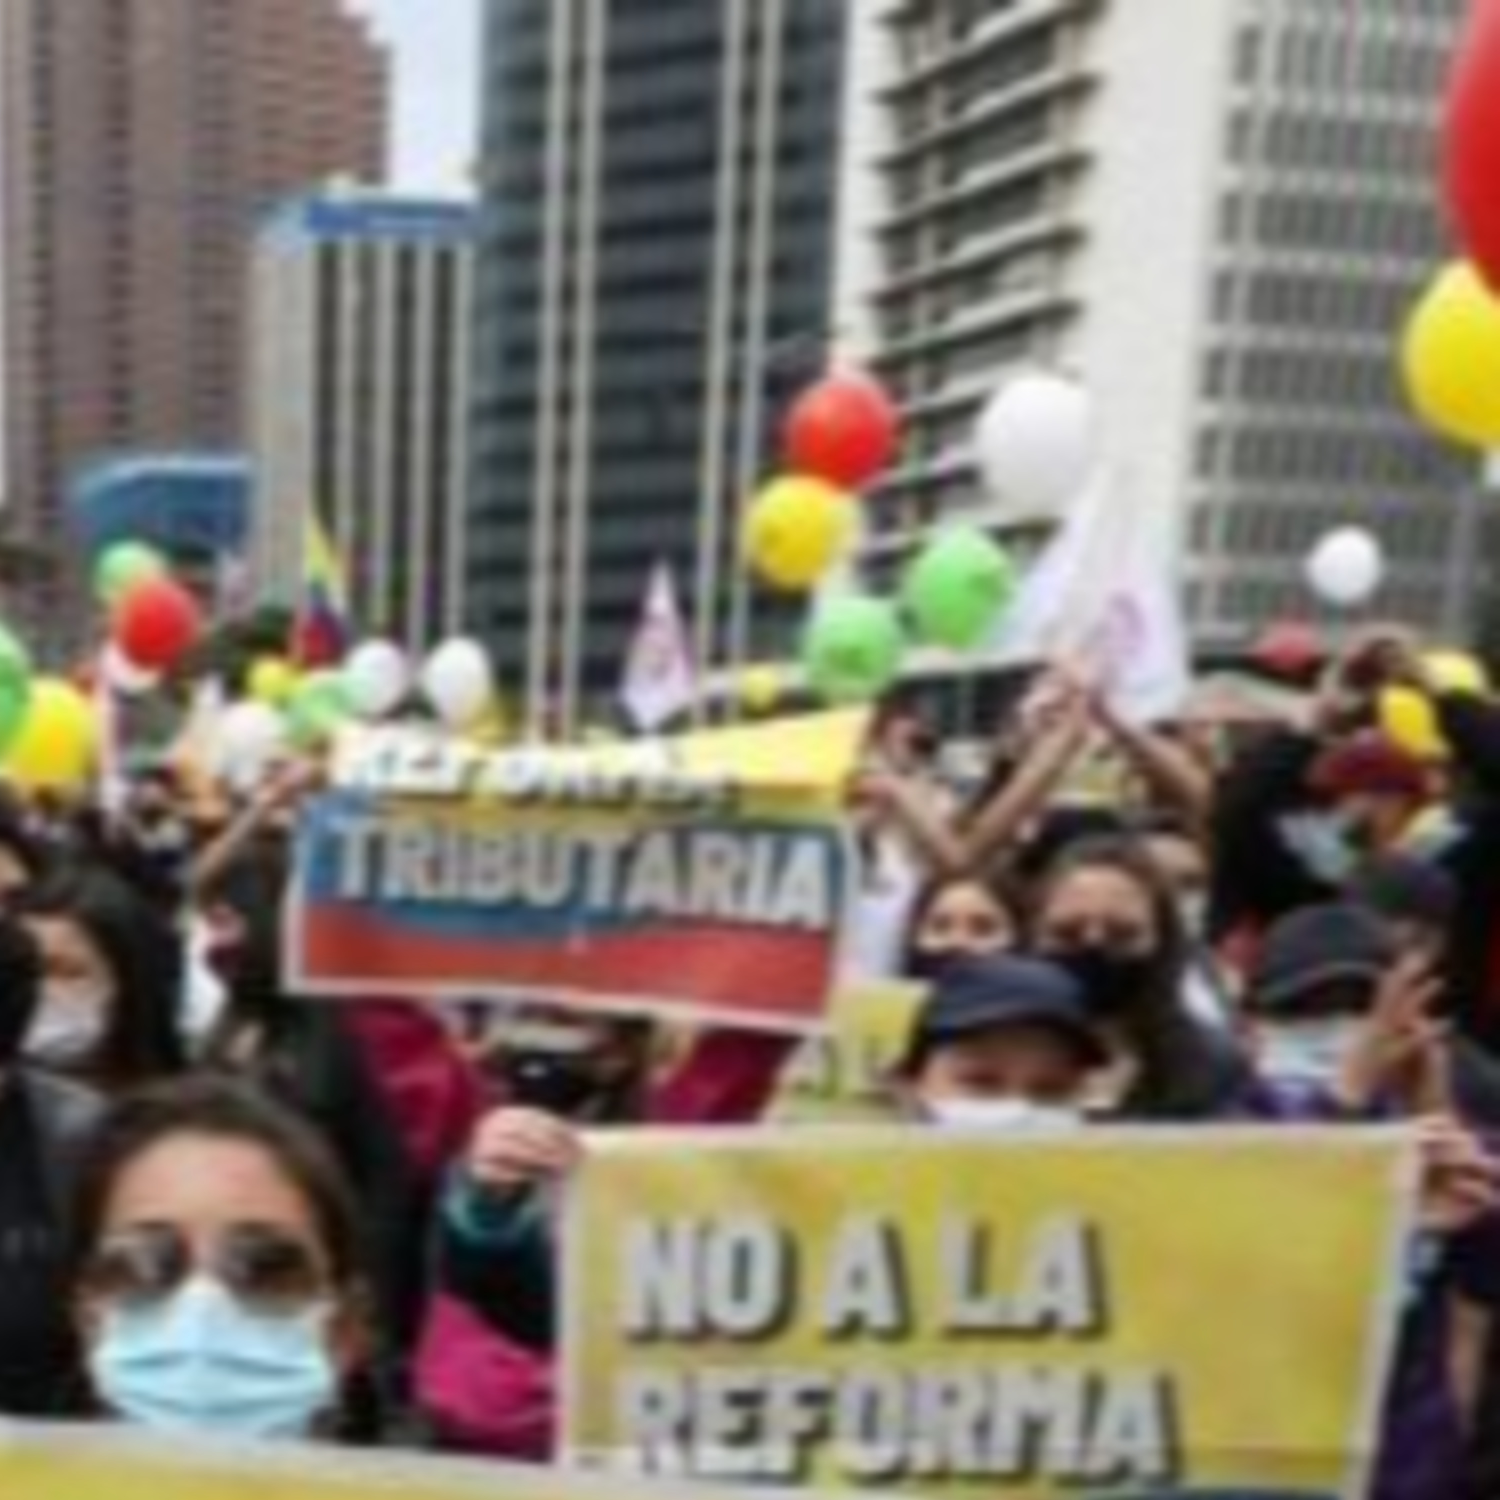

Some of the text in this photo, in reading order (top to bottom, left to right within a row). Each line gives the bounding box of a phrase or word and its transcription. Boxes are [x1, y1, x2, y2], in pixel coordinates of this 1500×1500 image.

[331, 808, 830, 925] TRIBUTARIA
[622, 1210, 1100, 1335] NO A LA
[618, 1364, 1175, 1478] REFORMA
